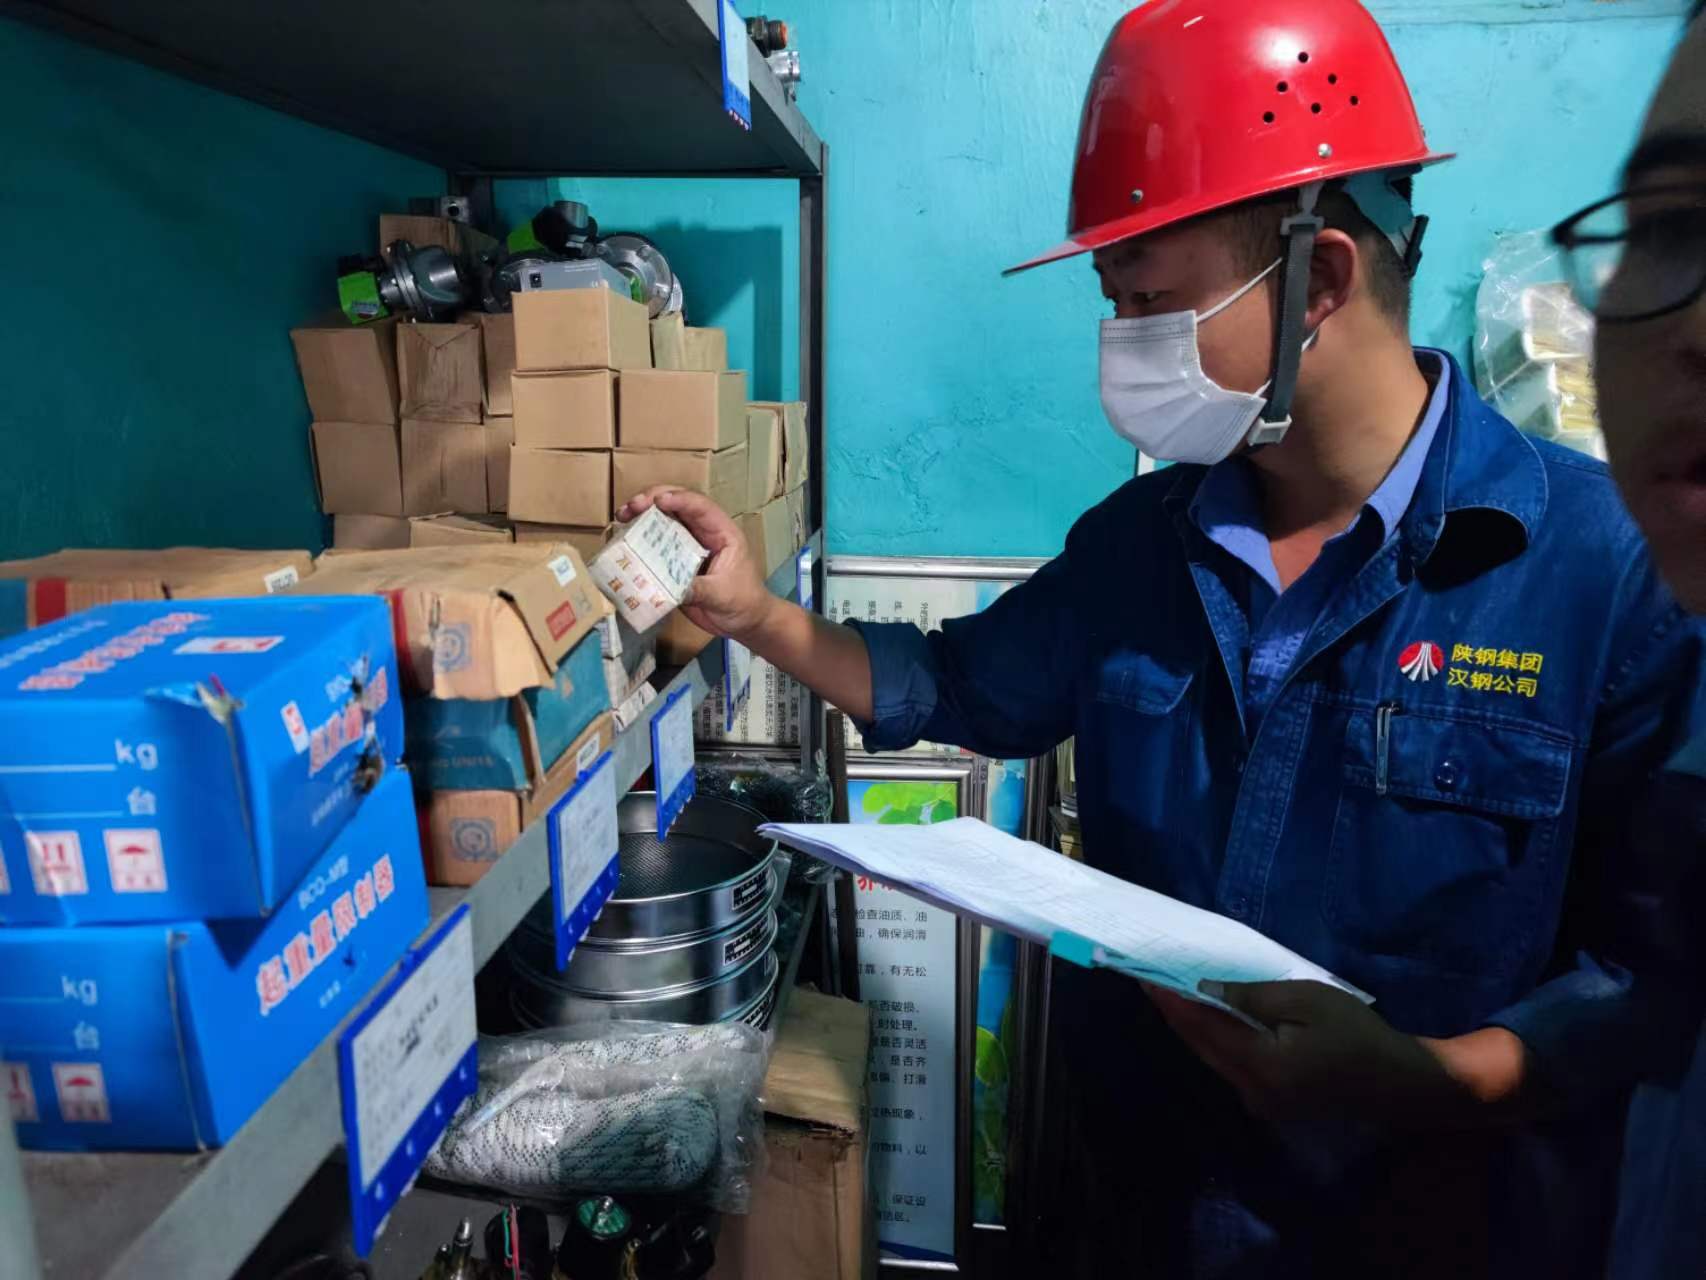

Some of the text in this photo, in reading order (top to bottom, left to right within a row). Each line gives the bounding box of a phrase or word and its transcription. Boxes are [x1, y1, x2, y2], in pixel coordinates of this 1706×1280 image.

[1451, 643, 1543, 674] 陕钢集团
[1447, 667, 1537, 698] 汉钢公司
[114, 739, 159, 771] kg
[127, 786, 157, 816] 台
[61, 975, 98, 1006] kg
[74, 1020, 100, 1051] 台
